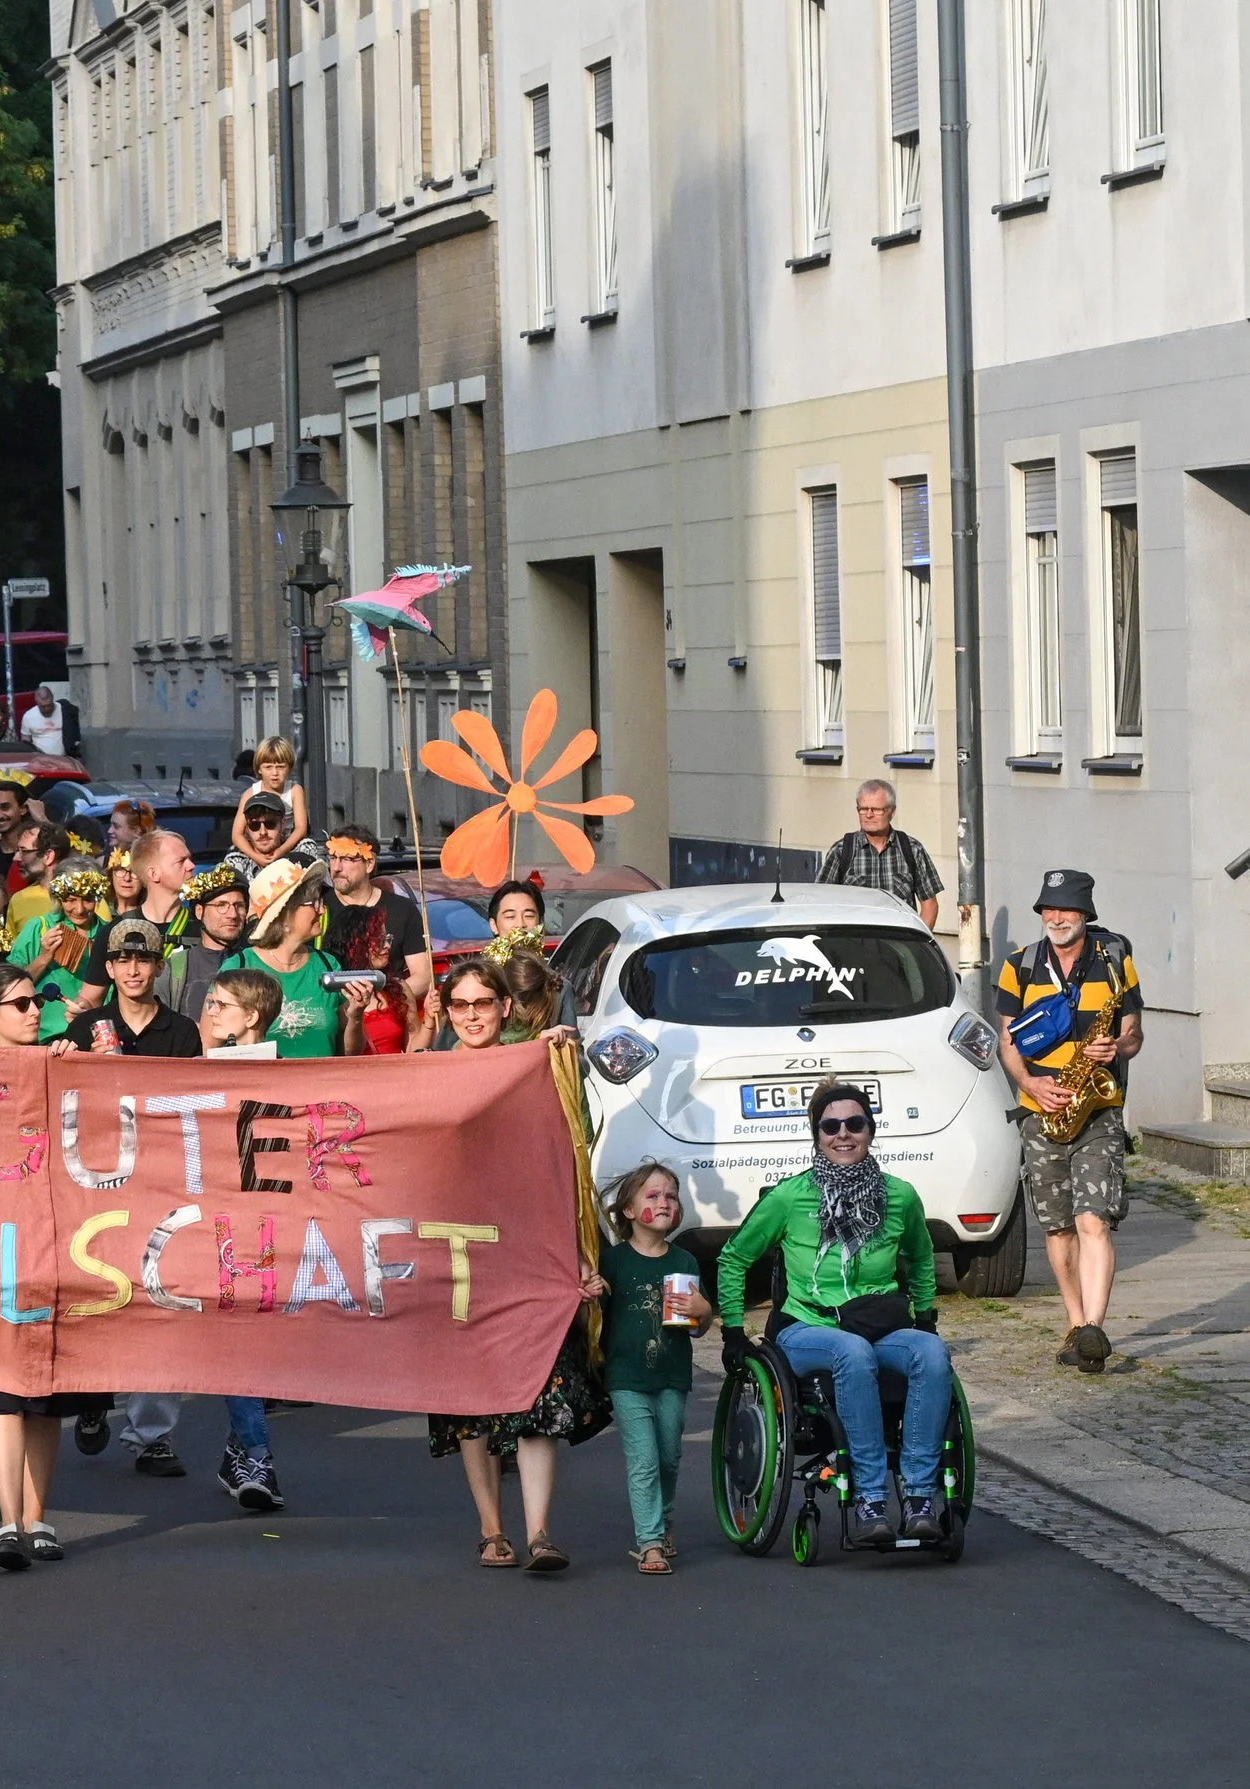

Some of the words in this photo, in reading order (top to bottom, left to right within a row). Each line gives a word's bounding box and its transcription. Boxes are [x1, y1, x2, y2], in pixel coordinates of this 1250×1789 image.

[784, 1057, 832, 1070] ZOE
[756, 1087, 786, 1109] FG
[875, 1150, 935, 1164] ngsdienst
